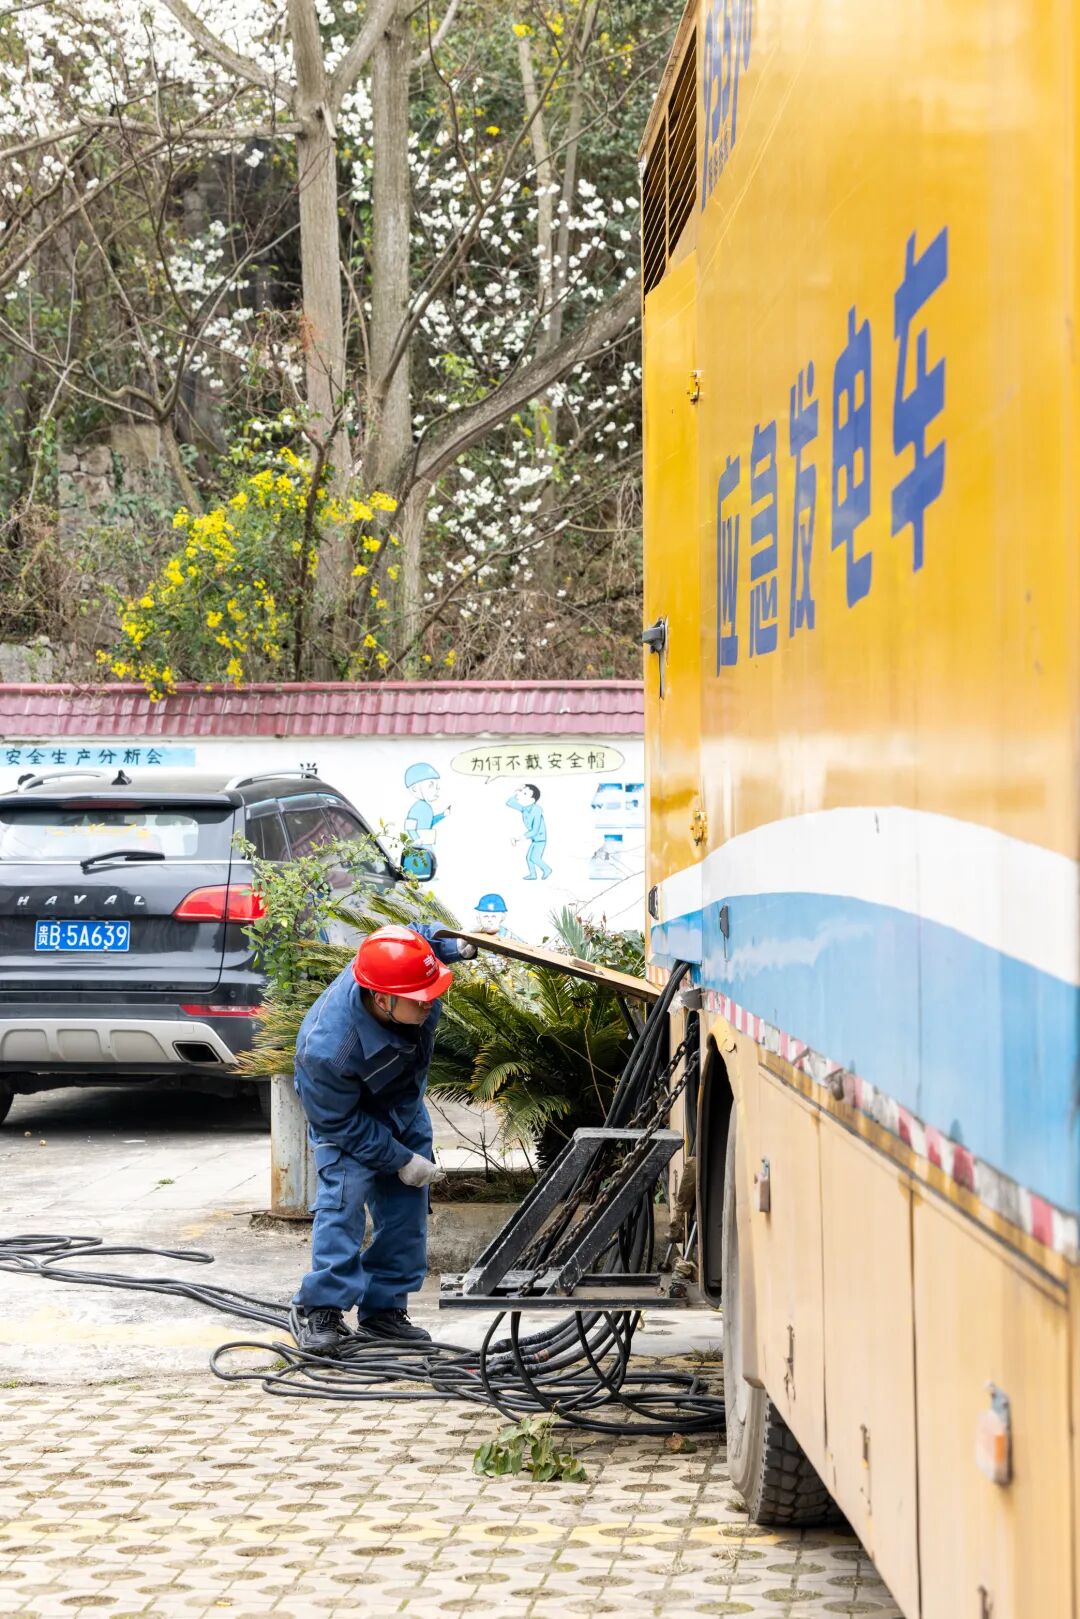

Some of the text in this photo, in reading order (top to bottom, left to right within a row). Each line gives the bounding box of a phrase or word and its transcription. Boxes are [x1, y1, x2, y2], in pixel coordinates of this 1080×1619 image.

[716, 225, 948, 677] 应急发电车
[6, 748, 163, 766] 安全生产分析会
[471, 751, 605, 771] 为何不戴安全帽
[17, 895, 145, 906] HAVAL
